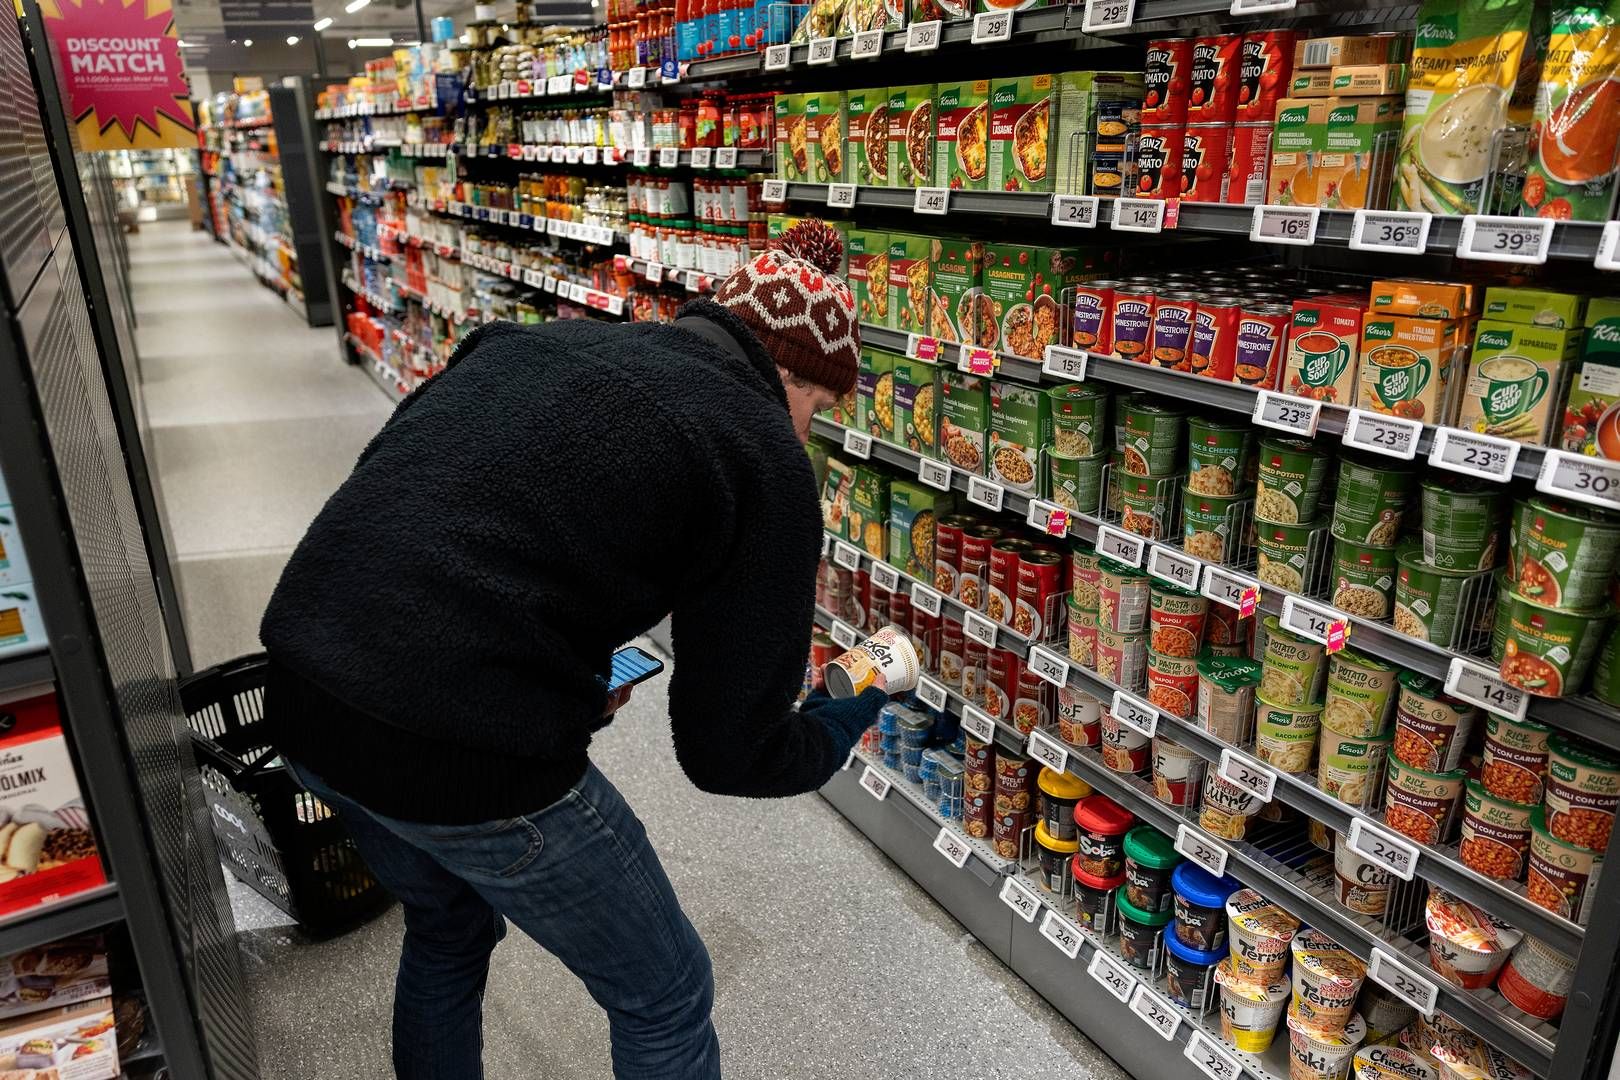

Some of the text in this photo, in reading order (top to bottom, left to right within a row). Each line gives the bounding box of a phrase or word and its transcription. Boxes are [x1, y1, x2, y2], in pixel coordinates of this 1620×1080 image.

[1417, 24, 1456, 40] Knorr
[67, 38, 160, 51] DISCOUNT
[70, 54, 165, 72] MATCH
[940, 96, 958, 105] Knorr
[994, 93, 1015, 103] Knorr
[1280, 112, 1307, 122] Knorr
[1328, 112, 1356, 122] Knorr
[1120, 304, 1147, 314] HEINZ
[1160, 309, 1186, 321] HEINZ
[1115, 318, 1148, 327] MINESTRONE
[1295, 313, 1318, 324] Knorr
[1333, 317, 1355, 327] TOMATO
[1241, 323, 1269, 337] HEINZ
[1366, 325, 1392, 337] Knorr
[1479, 334, 1509, 347] Knorr
[1519, 338, 1557, 350] ASPARAGUS
[1279, 407, 1311, 423] 2395
[1373, 428, 1410, 445] 2395
[1463, 449, 1507, 466] 2395
[1165, 599, 1189, 608] PASTA
[1543, 632, 1571, 643] SOUP
[1270, 639, 1297, 654] POTATO
[1158, 659, 1181, 670] PASTA
[1277, 661, 1299, 671] ONION
[1209, 665, 1255, 680] Knorr
[1338, 665, 1368, 682] POTATO
[1155, 676, 1175, 684] NAPOLI
[1354, 679, 1365, 688] POT
[1346, 690, 1370, 699] ONION
[1482, 684, 1520, 704] 1495
[1406, 695, 1424, 711] RICE
[1269, 713, 1290, 725] Knorr
[1411, 719, 1436, 732] CARNE
[1505, 730, 1528, 743] RICE
[1340, 744, 1364, 755] Knorr
[1514, 753, 1542, 763] CARNE
[1551, 762, 1573, 780] Knorr
[1404, 774, 1426, 788] RICE
[1587, 774, 1615, 786] RICE
[1215, 784, 1238, 797] SPICED
[1555, 787, 1574, 800] CHILI
[1412, 797, 1437, 808] CARNE
[1489, 807, 1512, 819] RICE
[1495, 829, 1524, 840] CARNE
[1080, 835, 1116, 857] Soba
[1374, 842, 1408, 865] 2495
[1540, 860, 1565, 879] CARNE
[1370, 1049, 1428, 1078] Chicken
